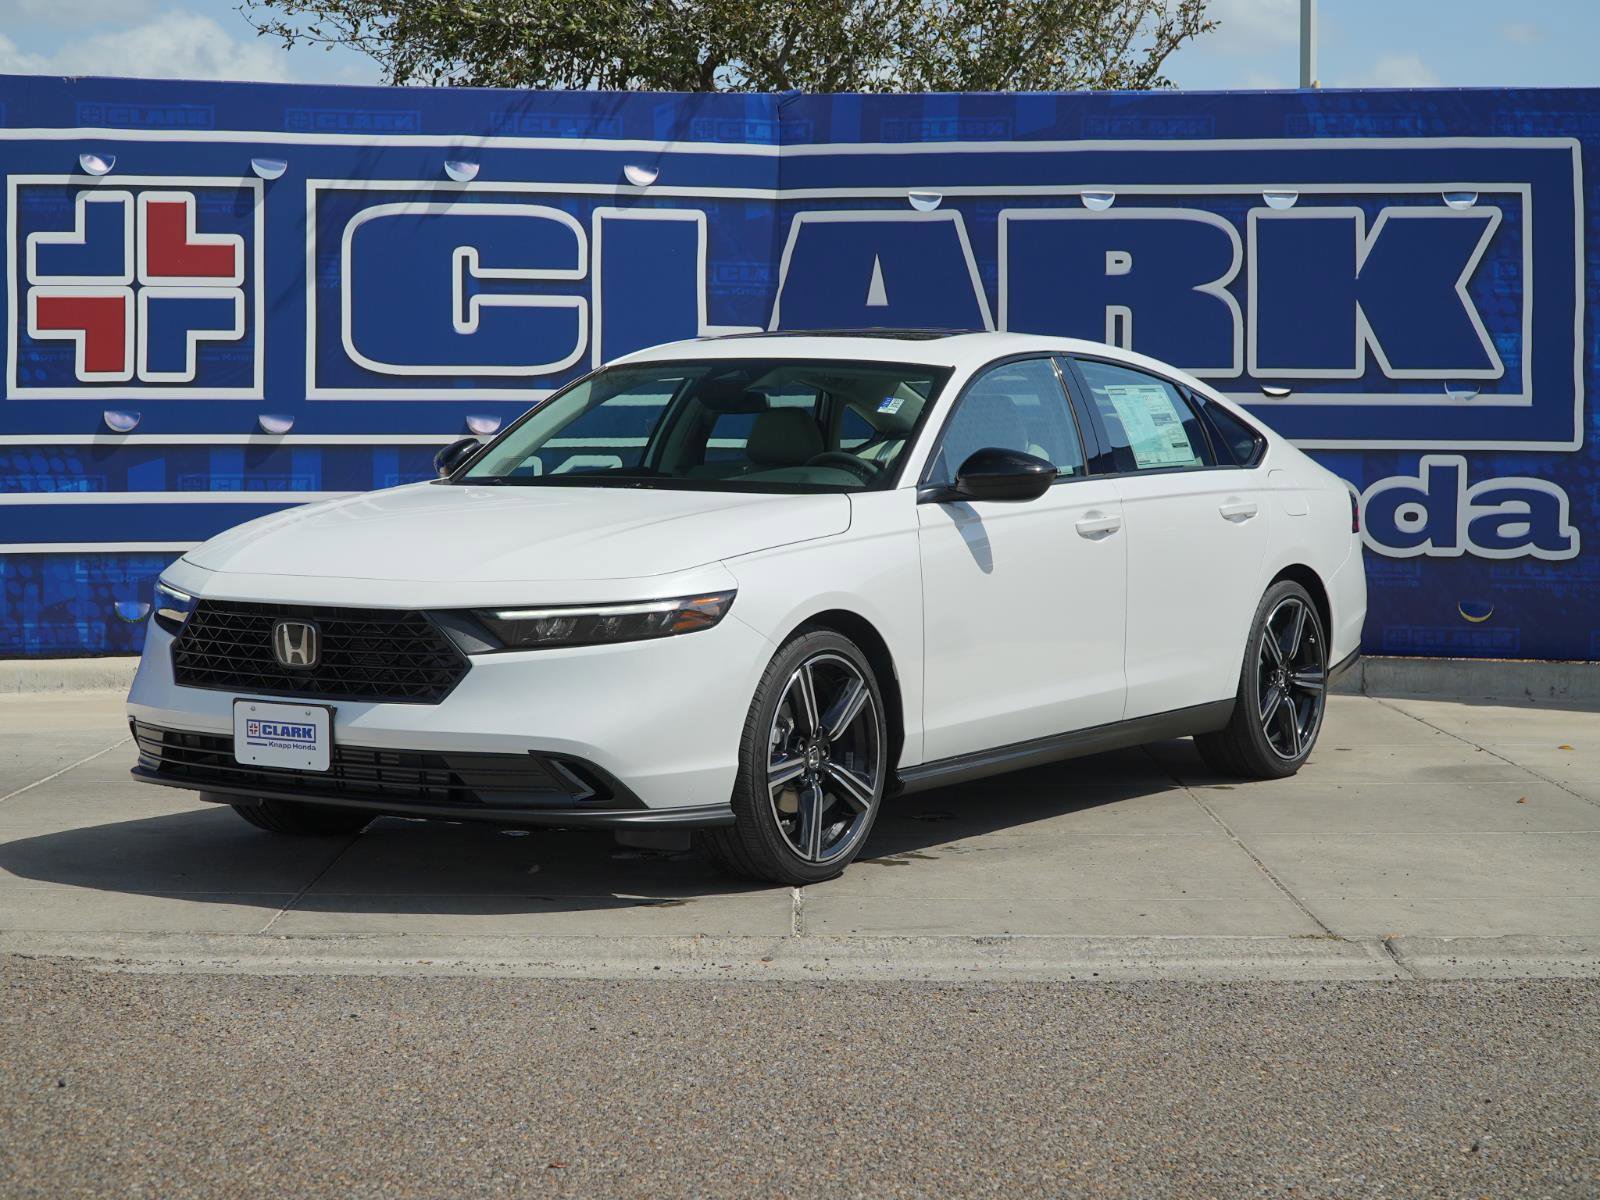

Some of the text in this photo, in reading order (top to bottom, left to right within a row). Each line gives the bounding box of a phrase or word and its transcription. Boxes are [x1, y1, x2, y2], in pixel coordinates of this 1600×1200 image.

[341, 202, 1504, 379] CLARK
[261, 724, 313, 739] CLARK
[268, 741, 317, 751] Knapp Honda
